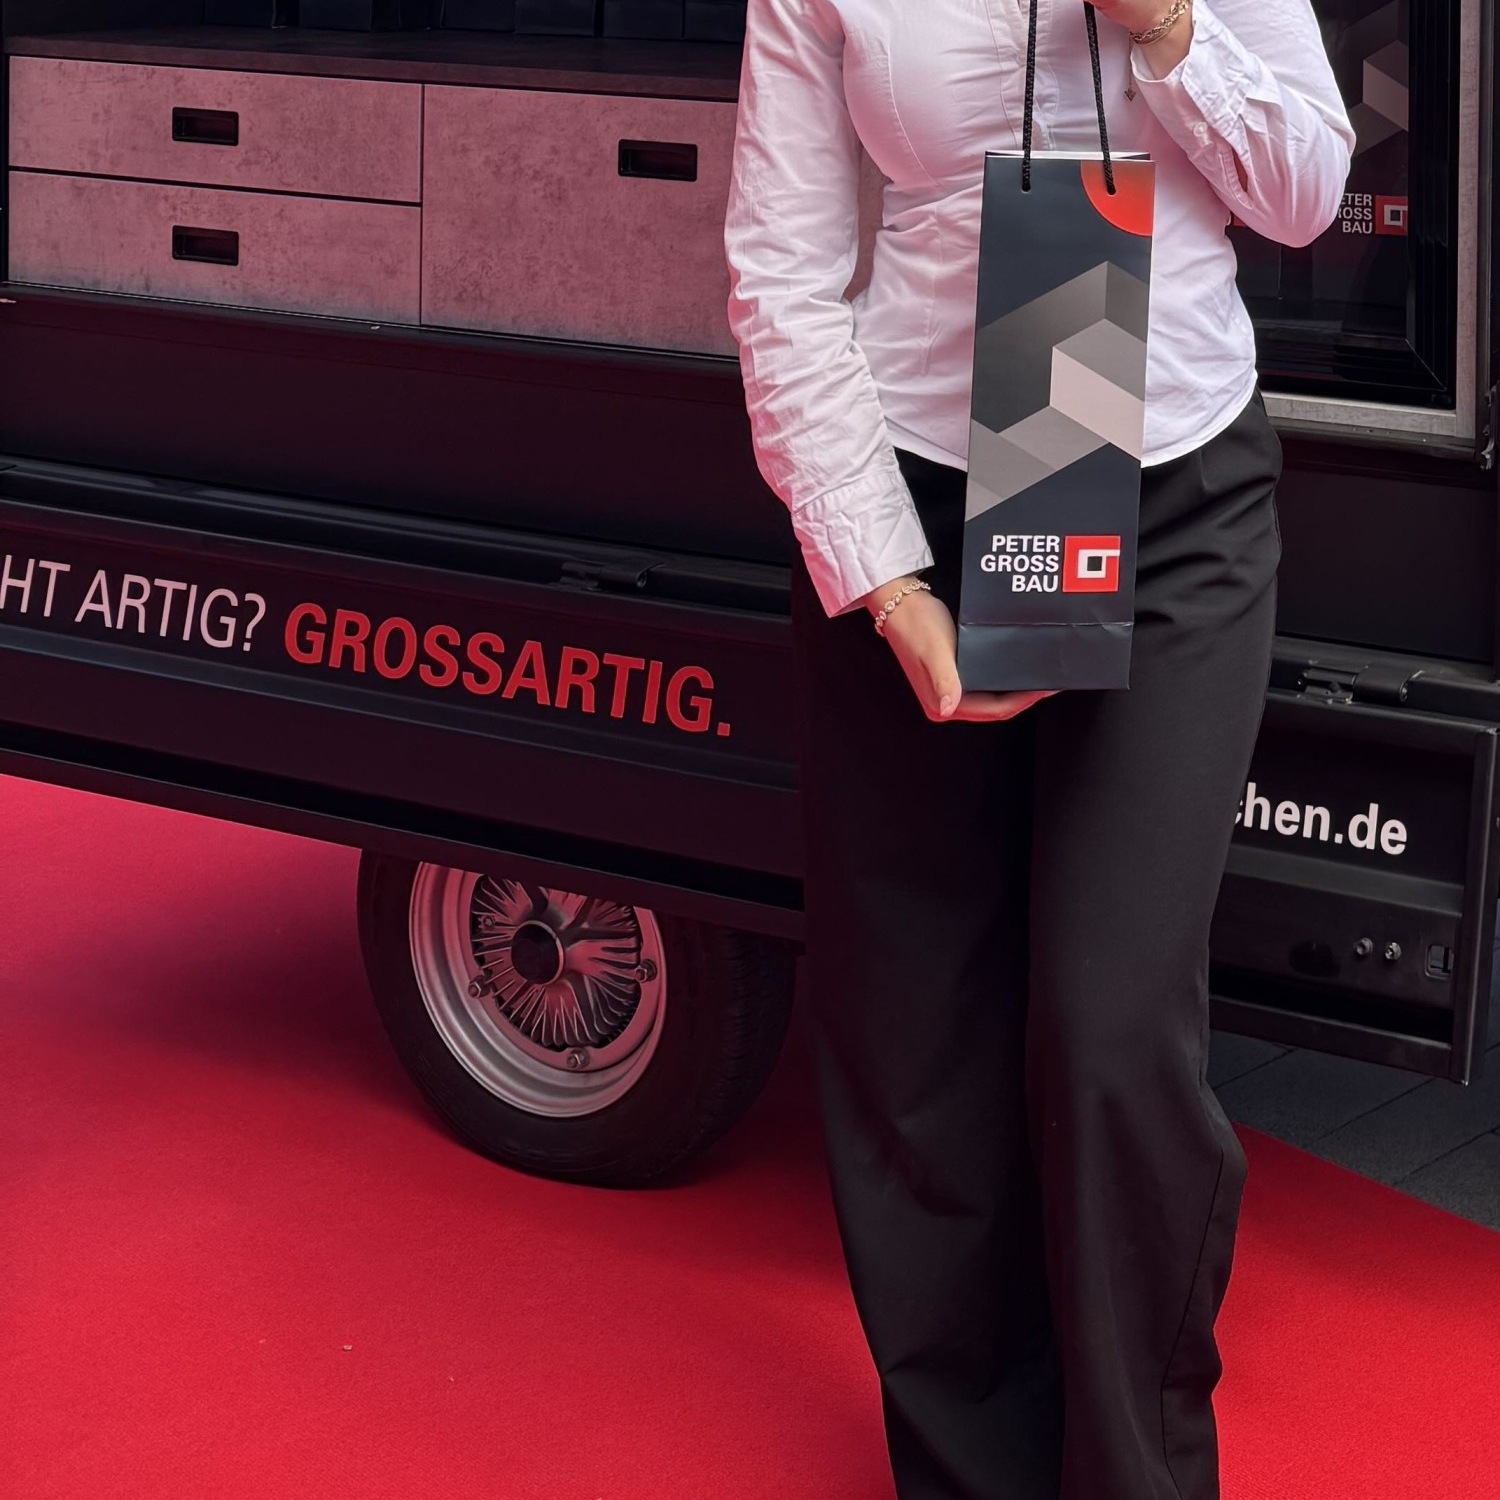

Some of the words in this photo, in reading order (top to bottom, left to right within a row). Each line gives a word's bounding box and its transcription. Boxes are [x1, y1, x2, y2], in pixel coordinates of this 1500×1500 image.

[1340, 193, 1373, 207] ETER
[1342, 221, 1373, 234] BAU
[991, 535, 1060, 553] PETER
[980, 554, 1060, 572] GROSS
[1011, 575, 1059, 593] BAU
[74, 569, 267, 652] ARTIG?
[284, 602, 732, 737] GROSSARTIG.
[1234, 782, 1408, 855] hen.de
